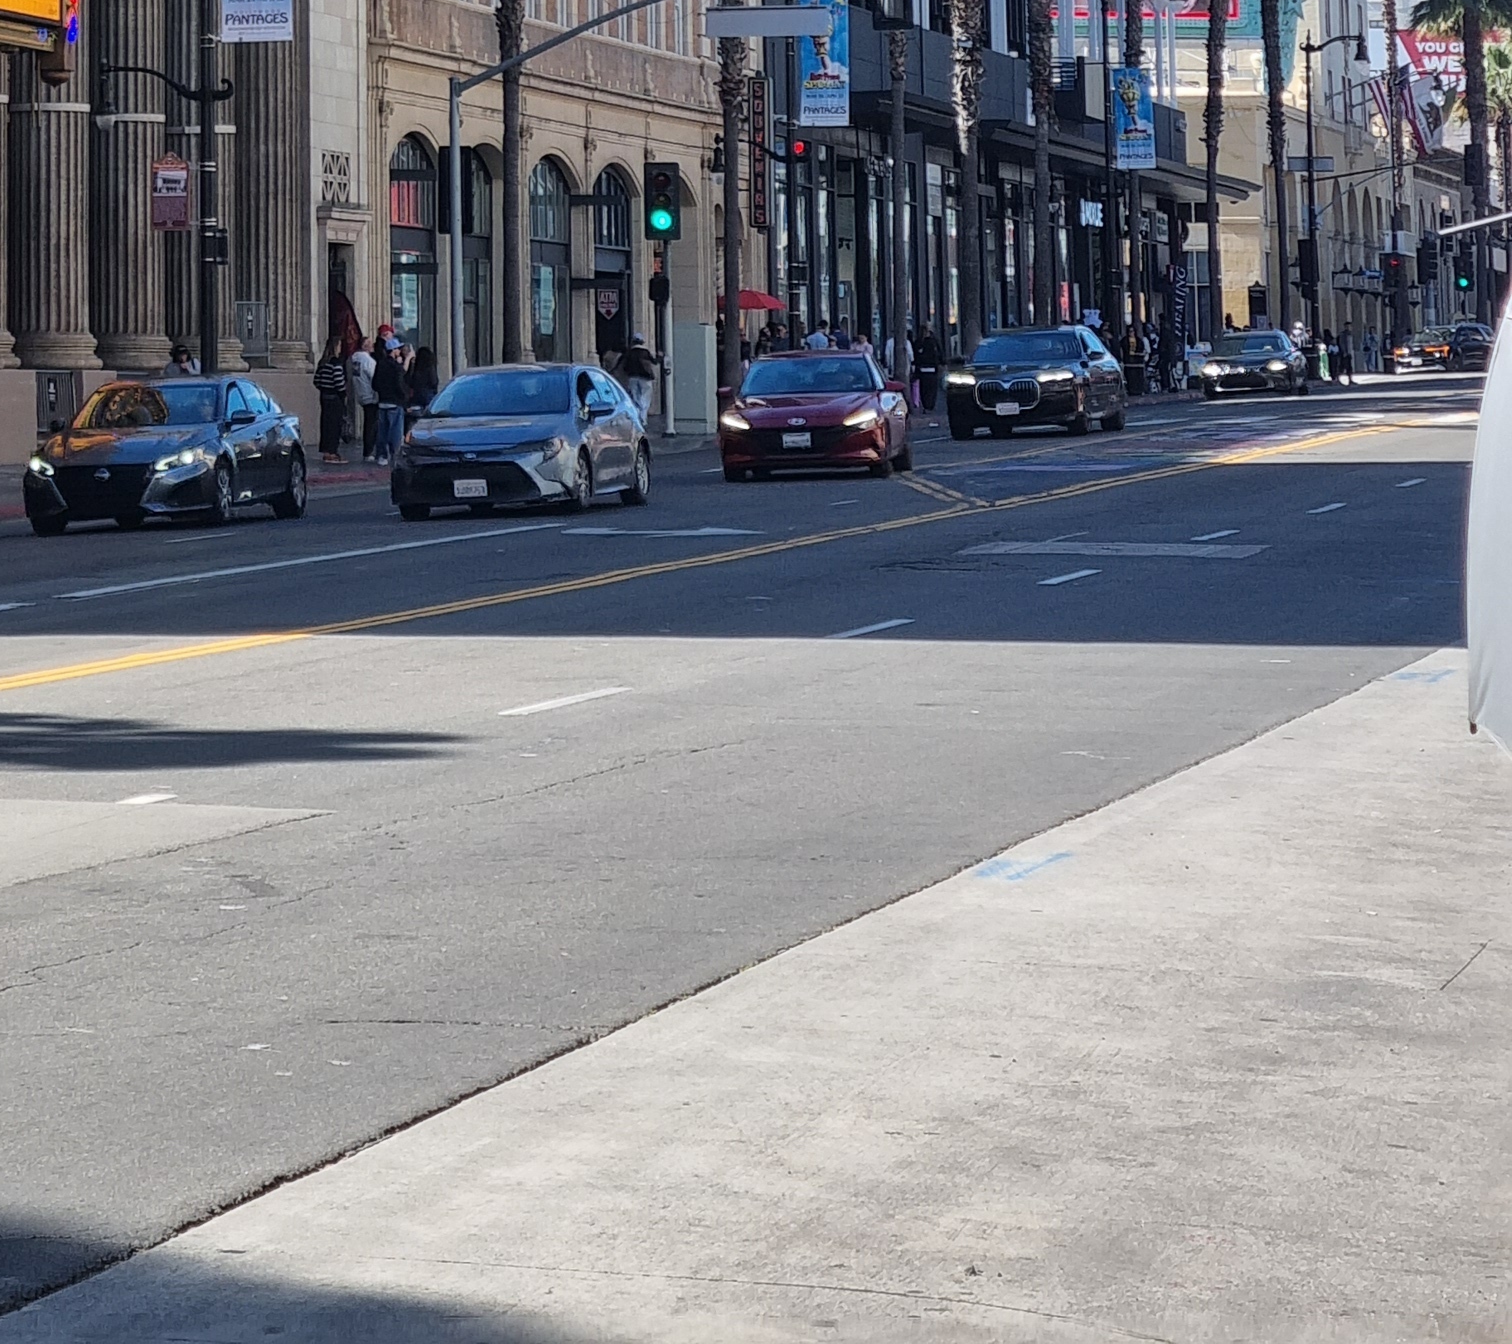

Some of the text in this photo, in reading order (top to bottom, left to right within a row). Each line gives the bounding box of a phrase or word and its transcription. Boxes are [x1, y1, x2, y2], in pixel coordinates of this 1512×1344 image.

[225, 12, 288, 25] PANTAGES
[1415, 42, 1446, 53] YOU
[803, 105, 847, 115] PANTAGES
